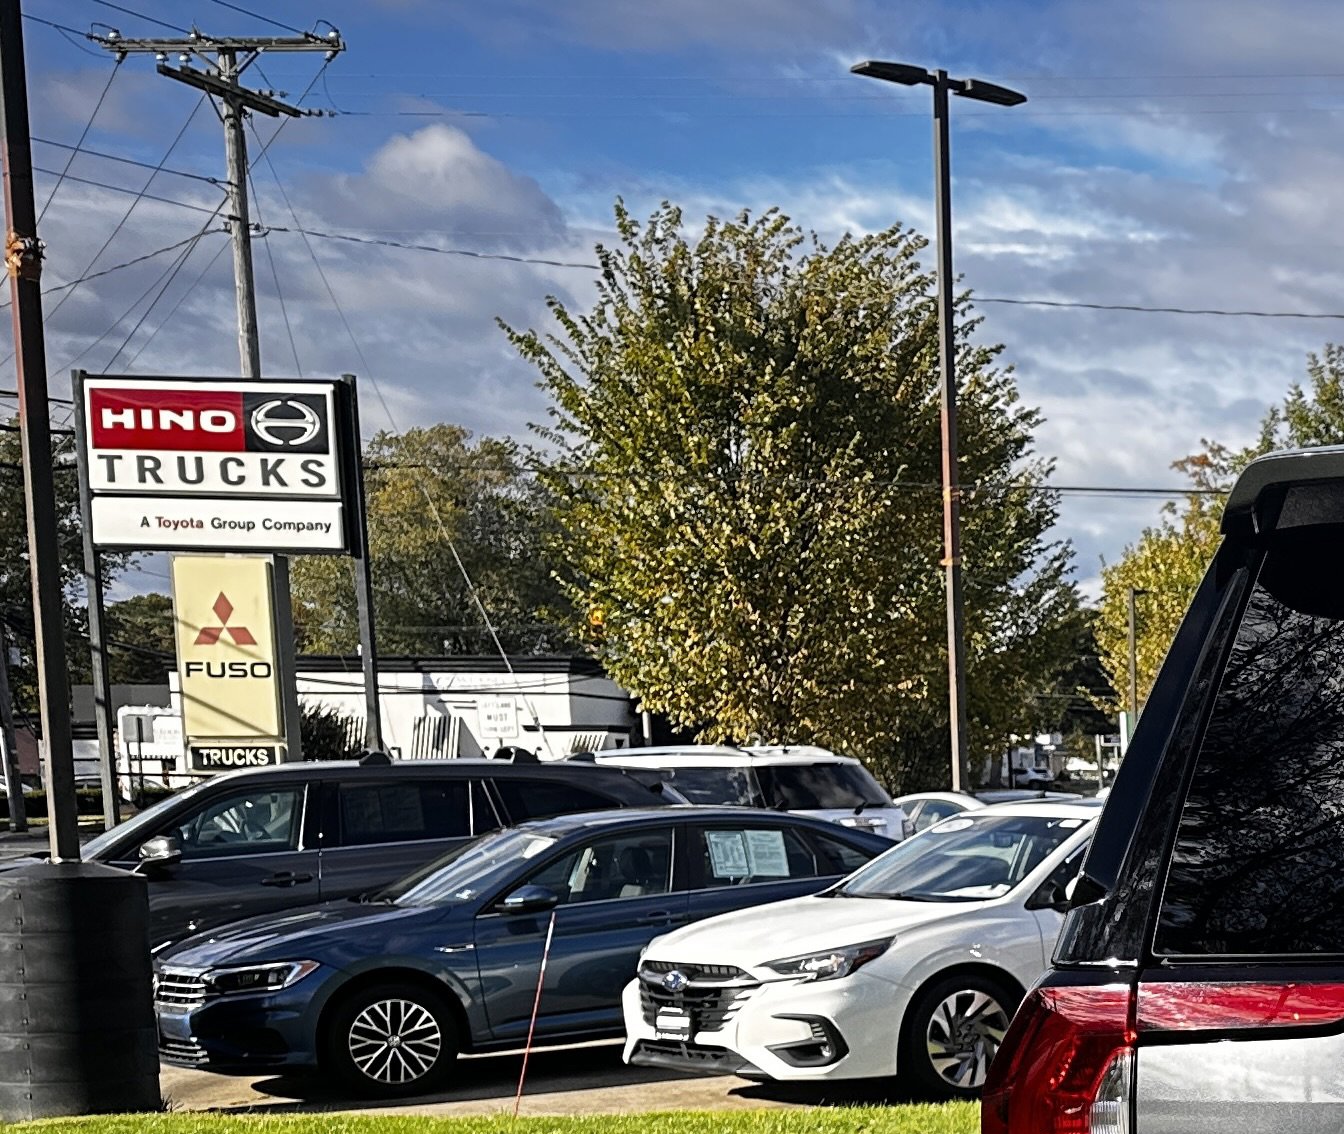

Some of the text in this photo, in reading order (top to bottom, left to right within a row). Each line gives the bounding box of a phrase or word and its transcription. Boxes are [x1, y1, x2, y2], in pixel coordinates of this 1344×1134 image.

[101, 408, 236, 433] HINO
[97, 454, 326, 488] TRUCKS
[140, 516, 332, 533] A Toyota Group Company
[185, 661, 272, 679] FUSO
[199, 748, 270, 766] TRUCKS
